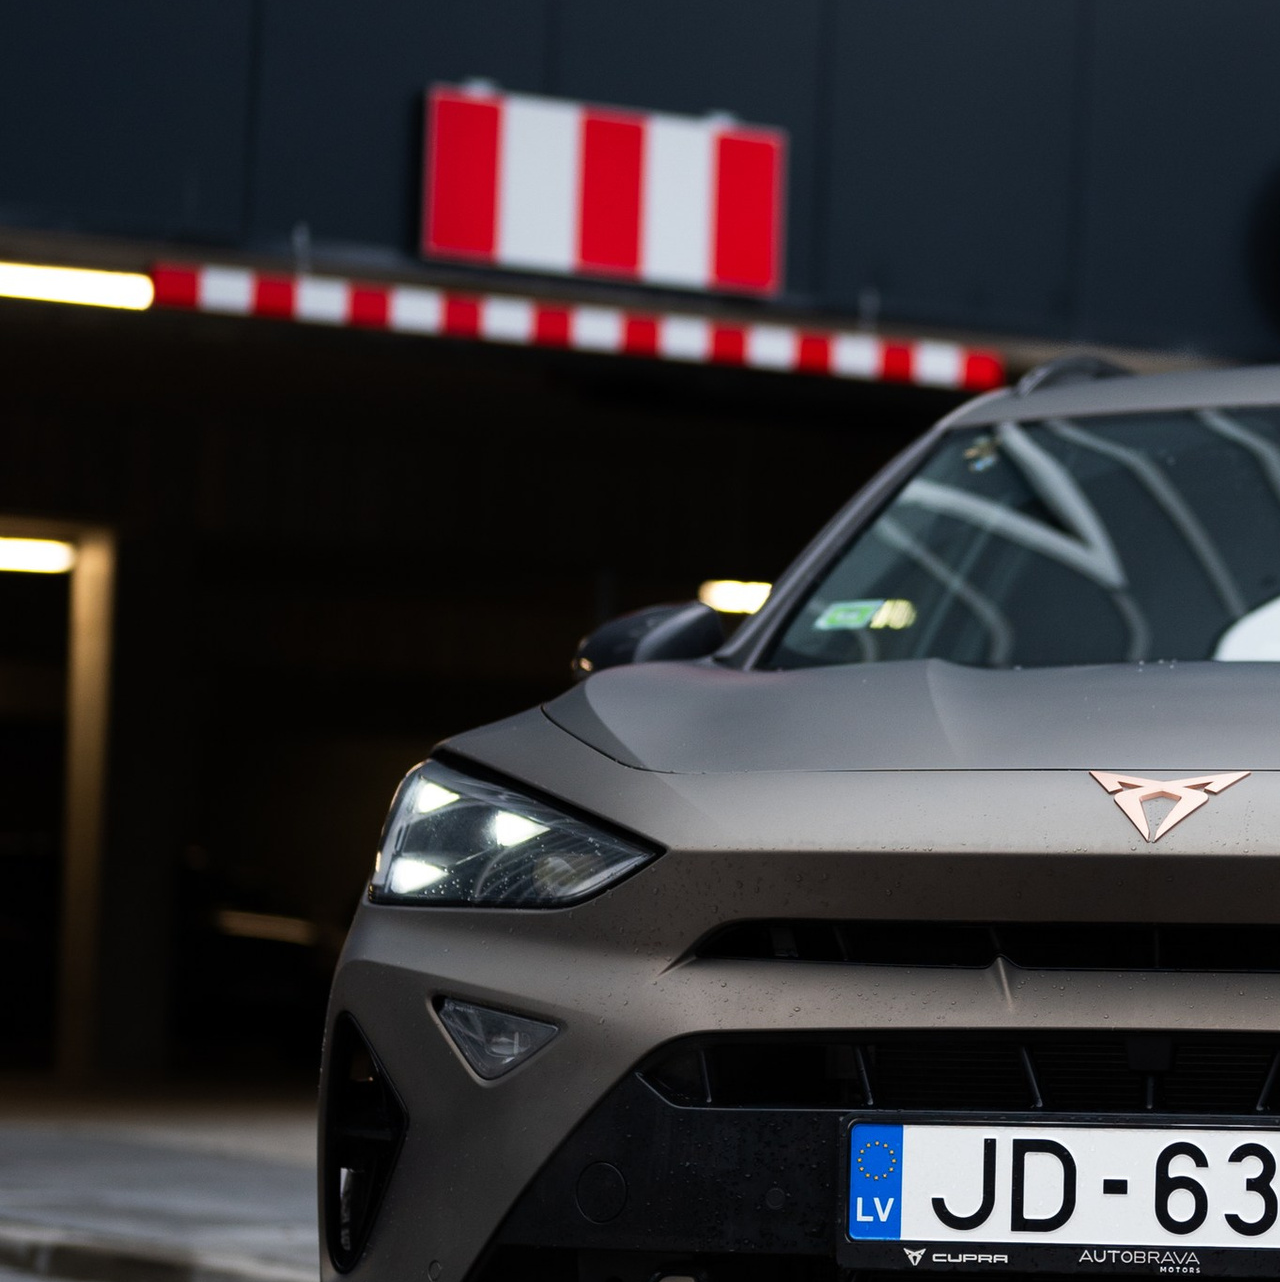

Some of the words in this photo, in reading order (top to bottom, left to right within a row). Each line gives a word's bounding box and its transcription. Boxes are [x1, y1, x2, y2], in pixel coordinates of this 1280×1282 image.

[856, 1196, 895, 1222] LV
[931, 1253, 1009, 1264] CUPRA
[1078, 1249, 1201, 1265] AUTOBRAVA
[1159, 1266, 1202, 1274] MOTORS
